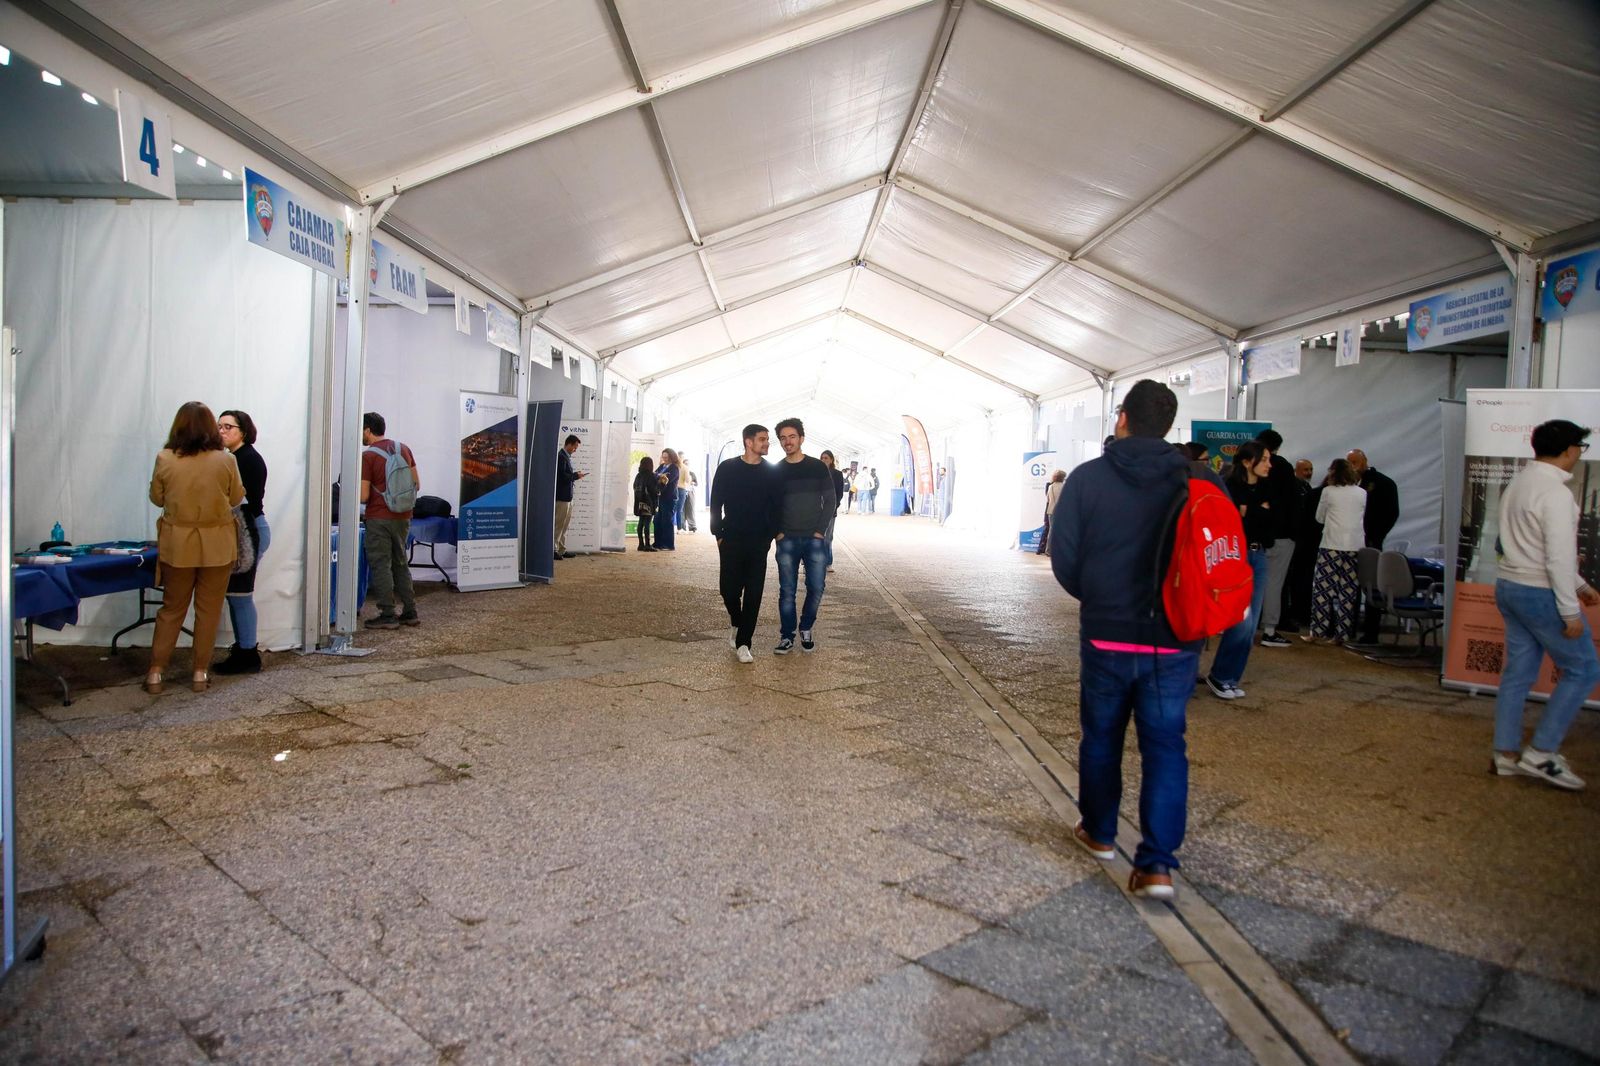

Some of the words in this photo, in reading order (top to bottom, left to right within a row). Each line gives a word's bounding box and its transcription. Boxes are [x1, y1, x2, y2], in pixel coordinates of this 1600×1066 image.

[139, 117, 160, 177] 4
[287, 200, 335, 247] CAJAMAR
[289, 230, 311, 258] CAJA
[311, 241, 336, 269] RURAL
[389, 263, 417, 299] FAAM
[1445, 297, 1467, 311] AGENCIA
[1467, 290, 1489, 305] ESTATAL
[1489, 288, 1498, 298] DE
[1497, 286, 1504, 297] LA
[1473, 320, 1481, 330] DE
[1481, 314, 1505, 328] ALMERÍA
[1206, 431, 1236, 440] GUARDIA
[1236, 432, 1253, 440] CIVIL
